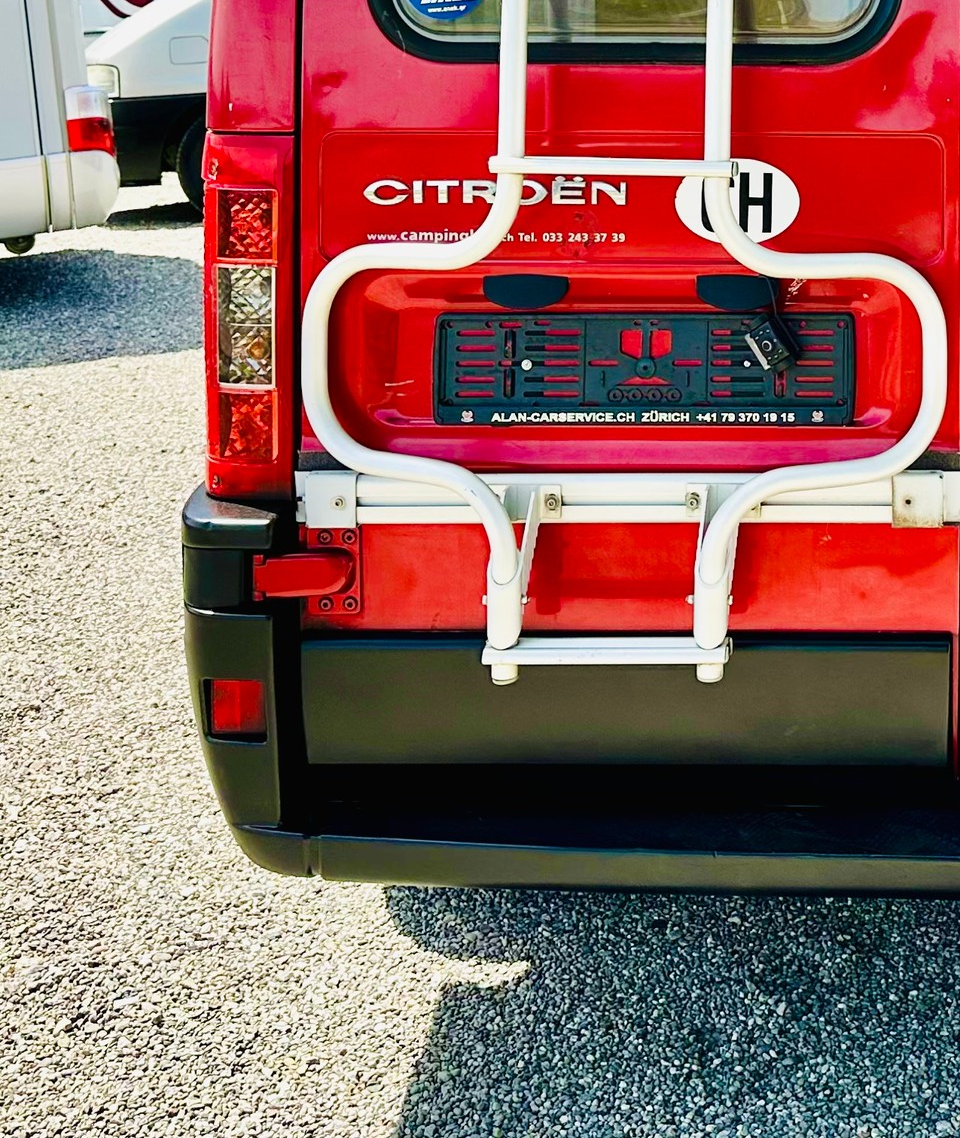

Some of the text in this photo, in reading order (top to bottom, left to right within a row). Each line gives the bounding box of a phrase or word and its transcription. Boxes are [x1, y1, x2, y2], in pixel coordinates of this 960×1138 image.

[518, 232, 537, 242] Tel.
[542, 232, 563, 242] 033
[568, 232, 589, 242] 243
[594, 232, 608, 242] 37
[611, 232, 626, 242] 39
[491, 410, 796, 423] ALAN-CARSERVICE.CH ZÜRICH +41 79 370 19 15
